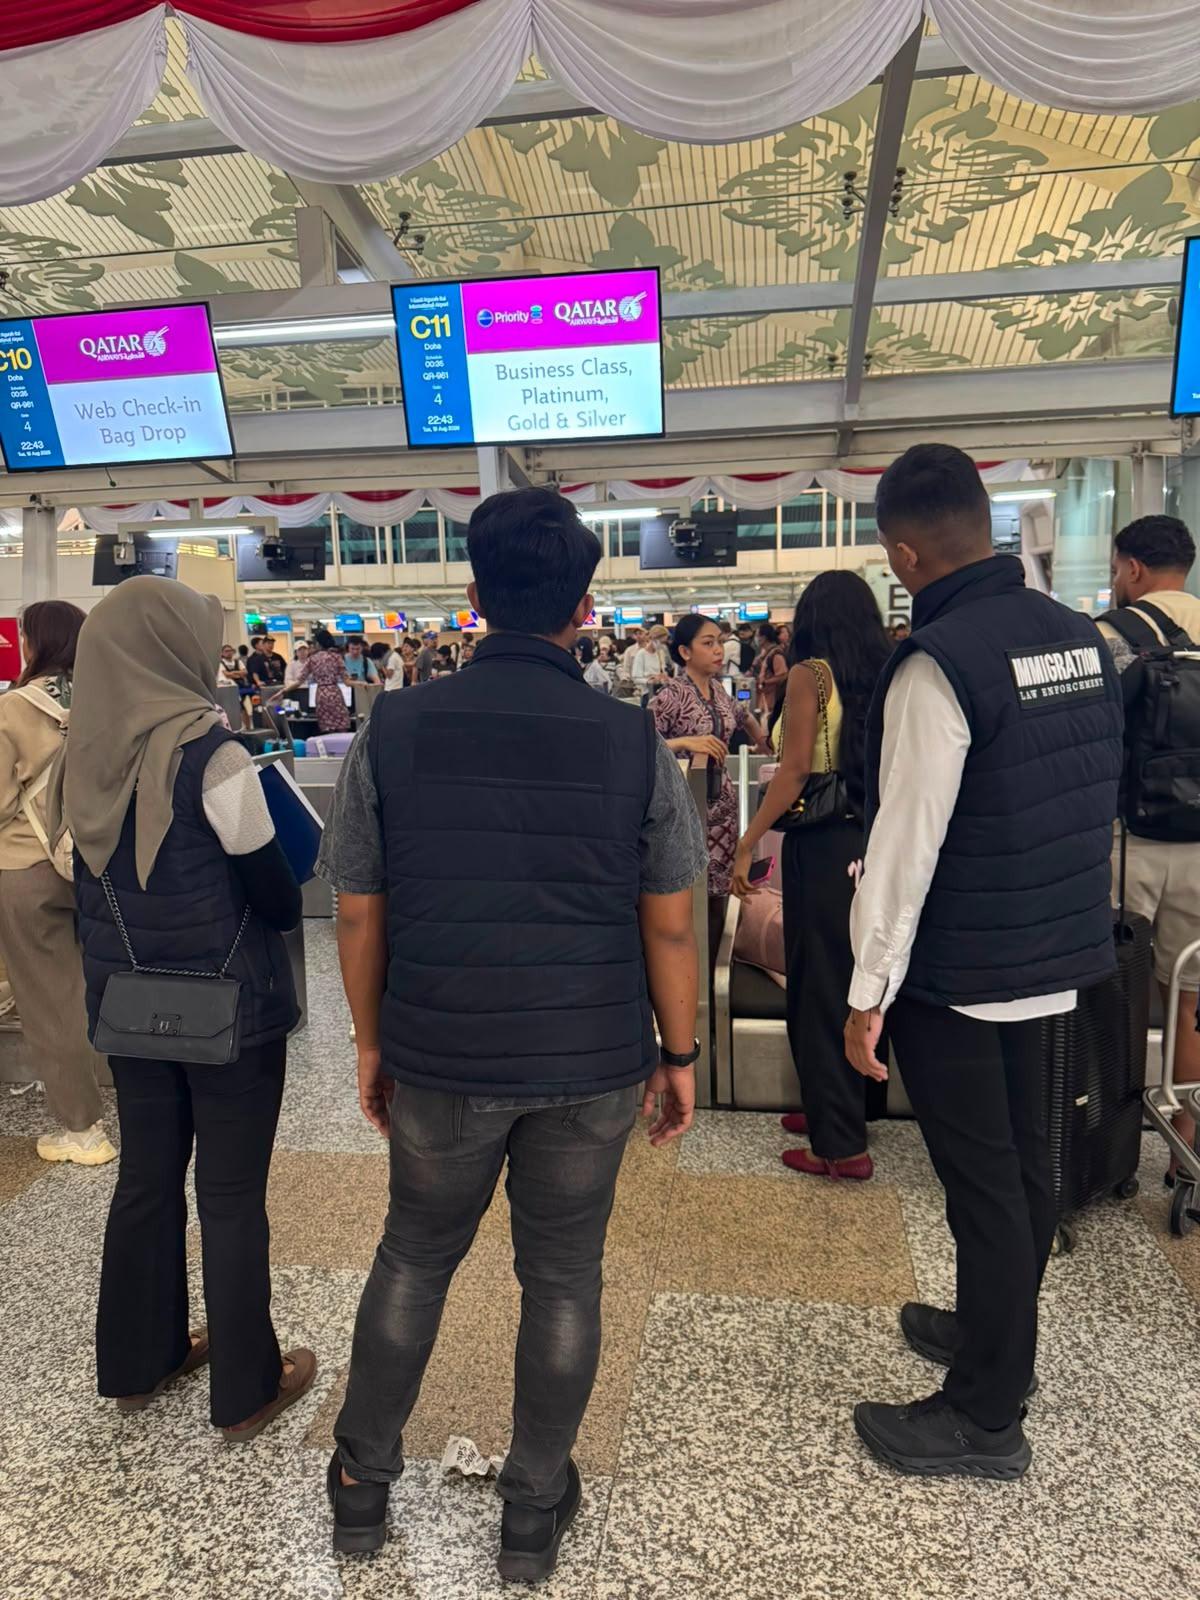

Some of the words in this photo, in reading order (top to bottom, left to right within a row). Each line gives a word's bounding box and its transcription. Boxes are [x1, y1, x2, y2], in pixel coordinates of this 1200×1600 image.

[495, 311, 529, 324] Priority
[555, 300, 617, 323] QATAR
[410, 314, 451, 339] C11
[80, 334, 143, 359] QATAR
[496, 362, 574, 380] Business
[581, 358, 632, 376] Class,
[434, 393, 442, 406] 4
[522, 386, 609, 404] Platinum,
[74, 401, 116, 420] Web
[122, 396, 202, 417] Check-in
[24, 421, 32, 432] 4
[428, 415, 453, 424] 22:43
[508, 412, 550, 430] Gold
[556, 412, 568, 428] &
[576, 410, 626, 428] Silver
[20, 440, 44, 450] 22:43
[100, 428, 136, 447] Bag
[140, 426, 186, 444] Drop
[1012, 646, 1102, 688] IMMIGRATION
[1020, 690, 1038, 700] LAW
[1041, 678, 1104, 697] ENFORCEMENT
